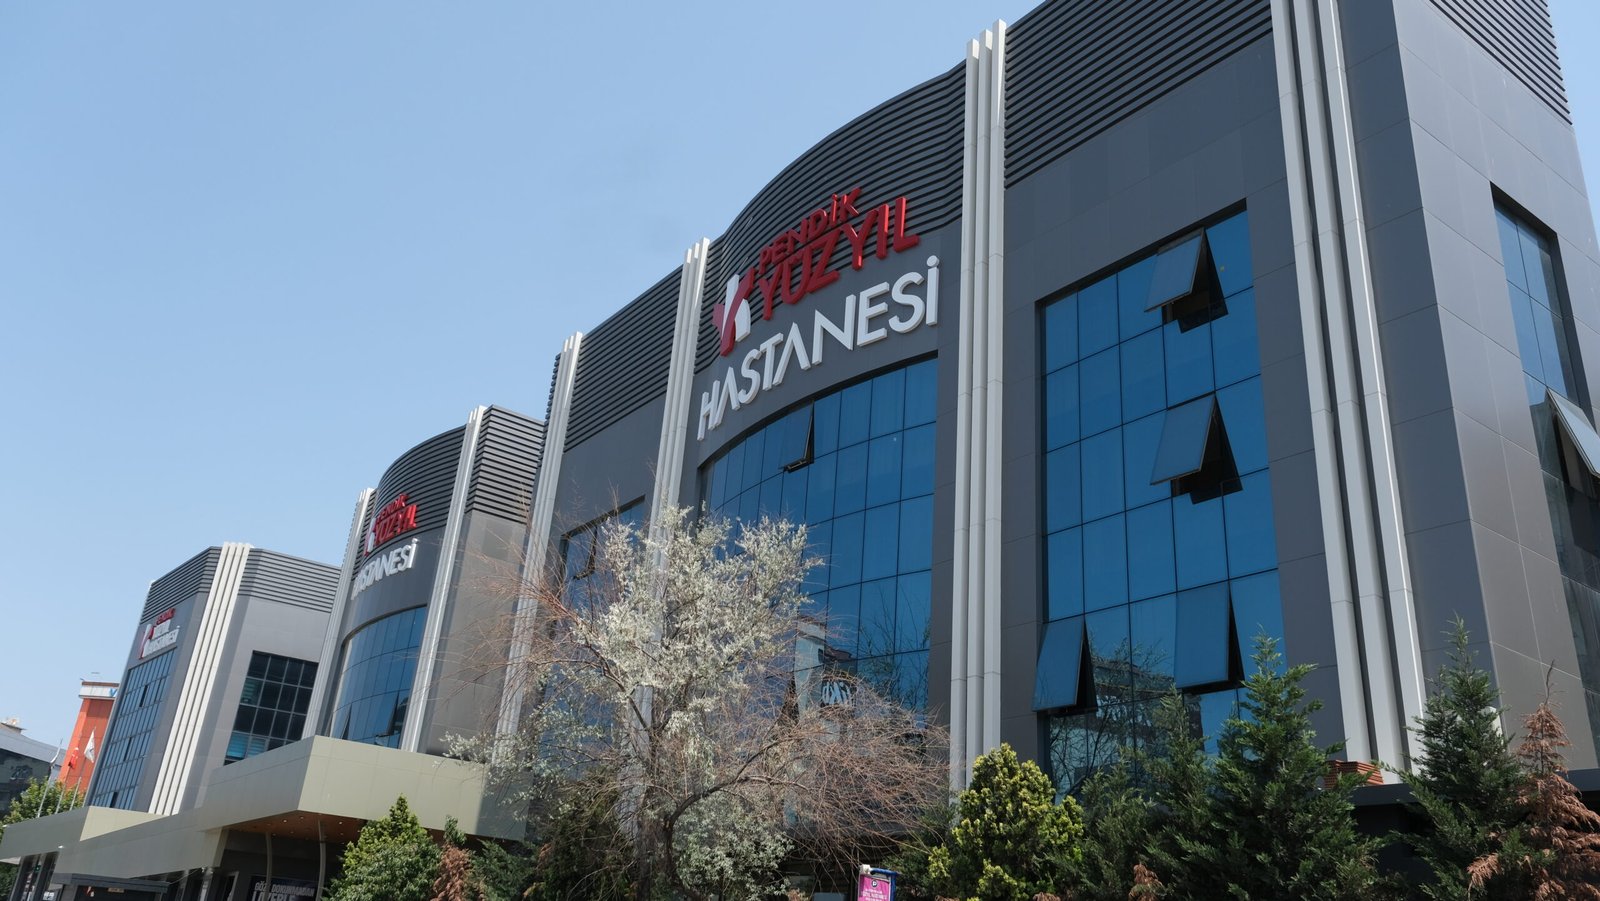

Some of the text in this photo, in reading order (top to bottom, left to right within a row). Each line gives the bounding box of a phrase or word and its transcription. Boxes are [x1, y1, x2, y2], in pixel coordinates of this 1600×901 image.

[758, 187, 862, 275] PENDİK
[758, 196, 921, 321] YÜZYIL
[697, 255, 940, 441] HASTANESİ
